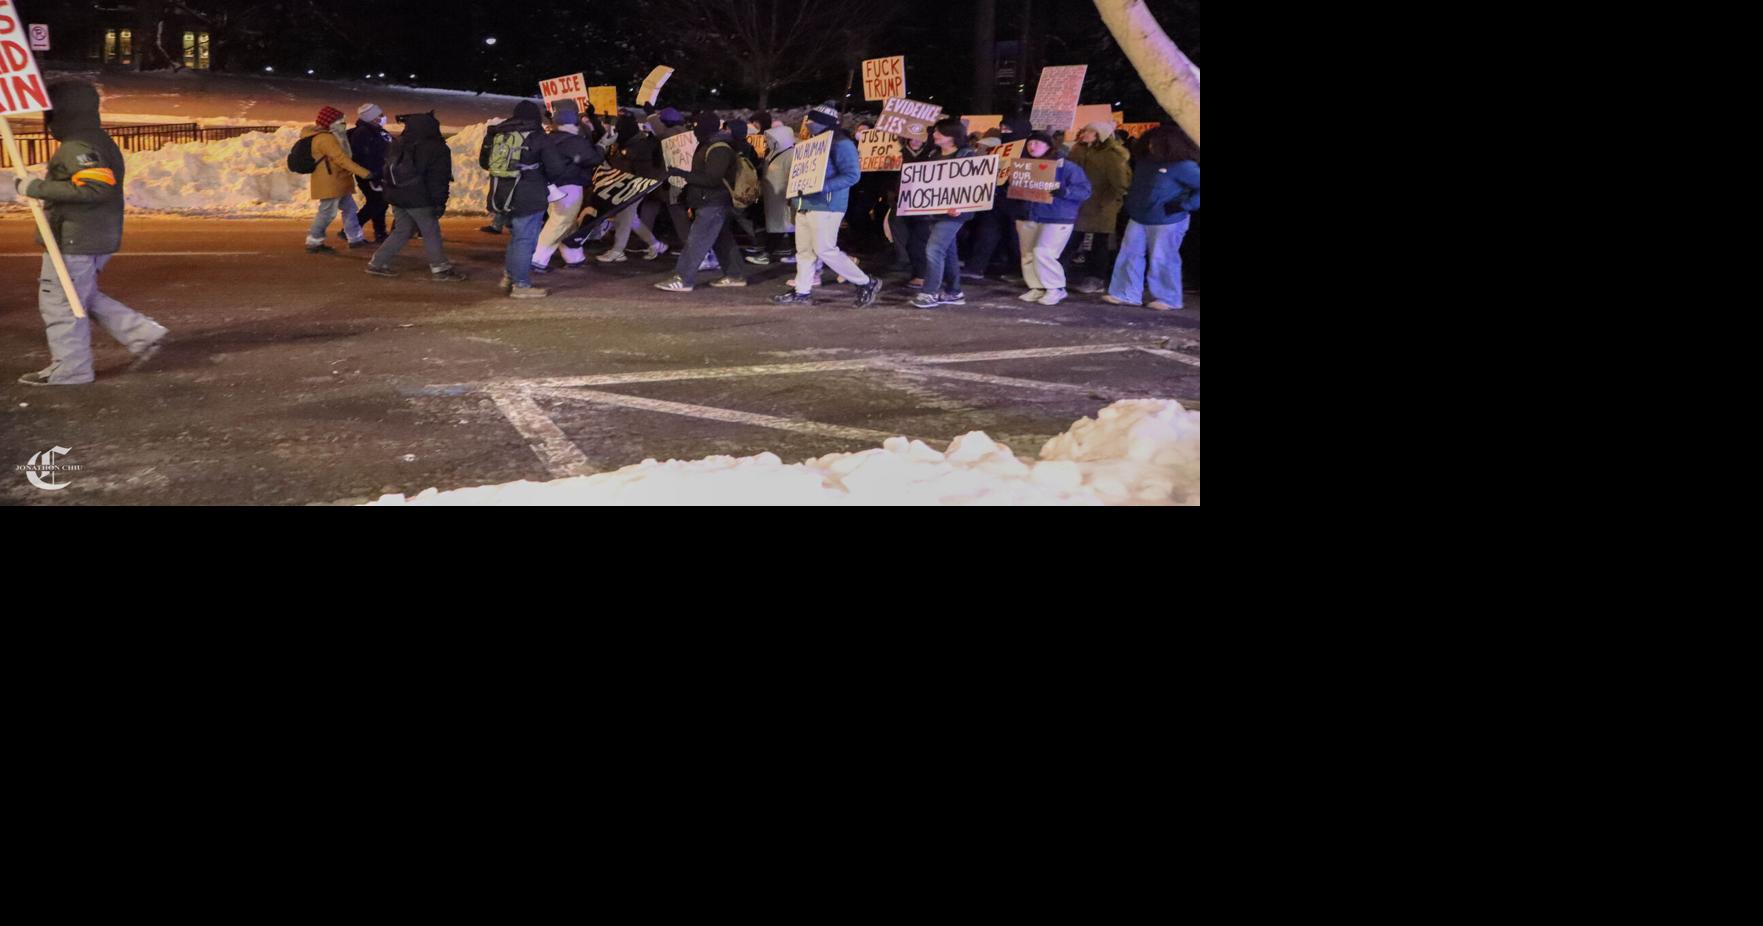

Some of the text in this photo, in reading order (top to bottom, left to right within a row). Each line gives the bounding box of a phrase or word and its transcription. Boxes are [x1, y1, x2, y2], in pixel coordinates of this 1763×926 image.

[866, 59, 900, 78] FUCK
[542, 76, 580, 97] NO ICE
[866, 77, 902, 98] TRUMP
[884, 97, 942, 121] EVIDENCE
[876, 114, 906, 134] LIES
[902, 162, 948, 184] SHUT
[949, 157, 995, 179] DOWN
[1012, 171, 1031, 180] OUR
[1013, 161, 1032, 170] WE
[898, 182, 994, 208] MOSHANNON
